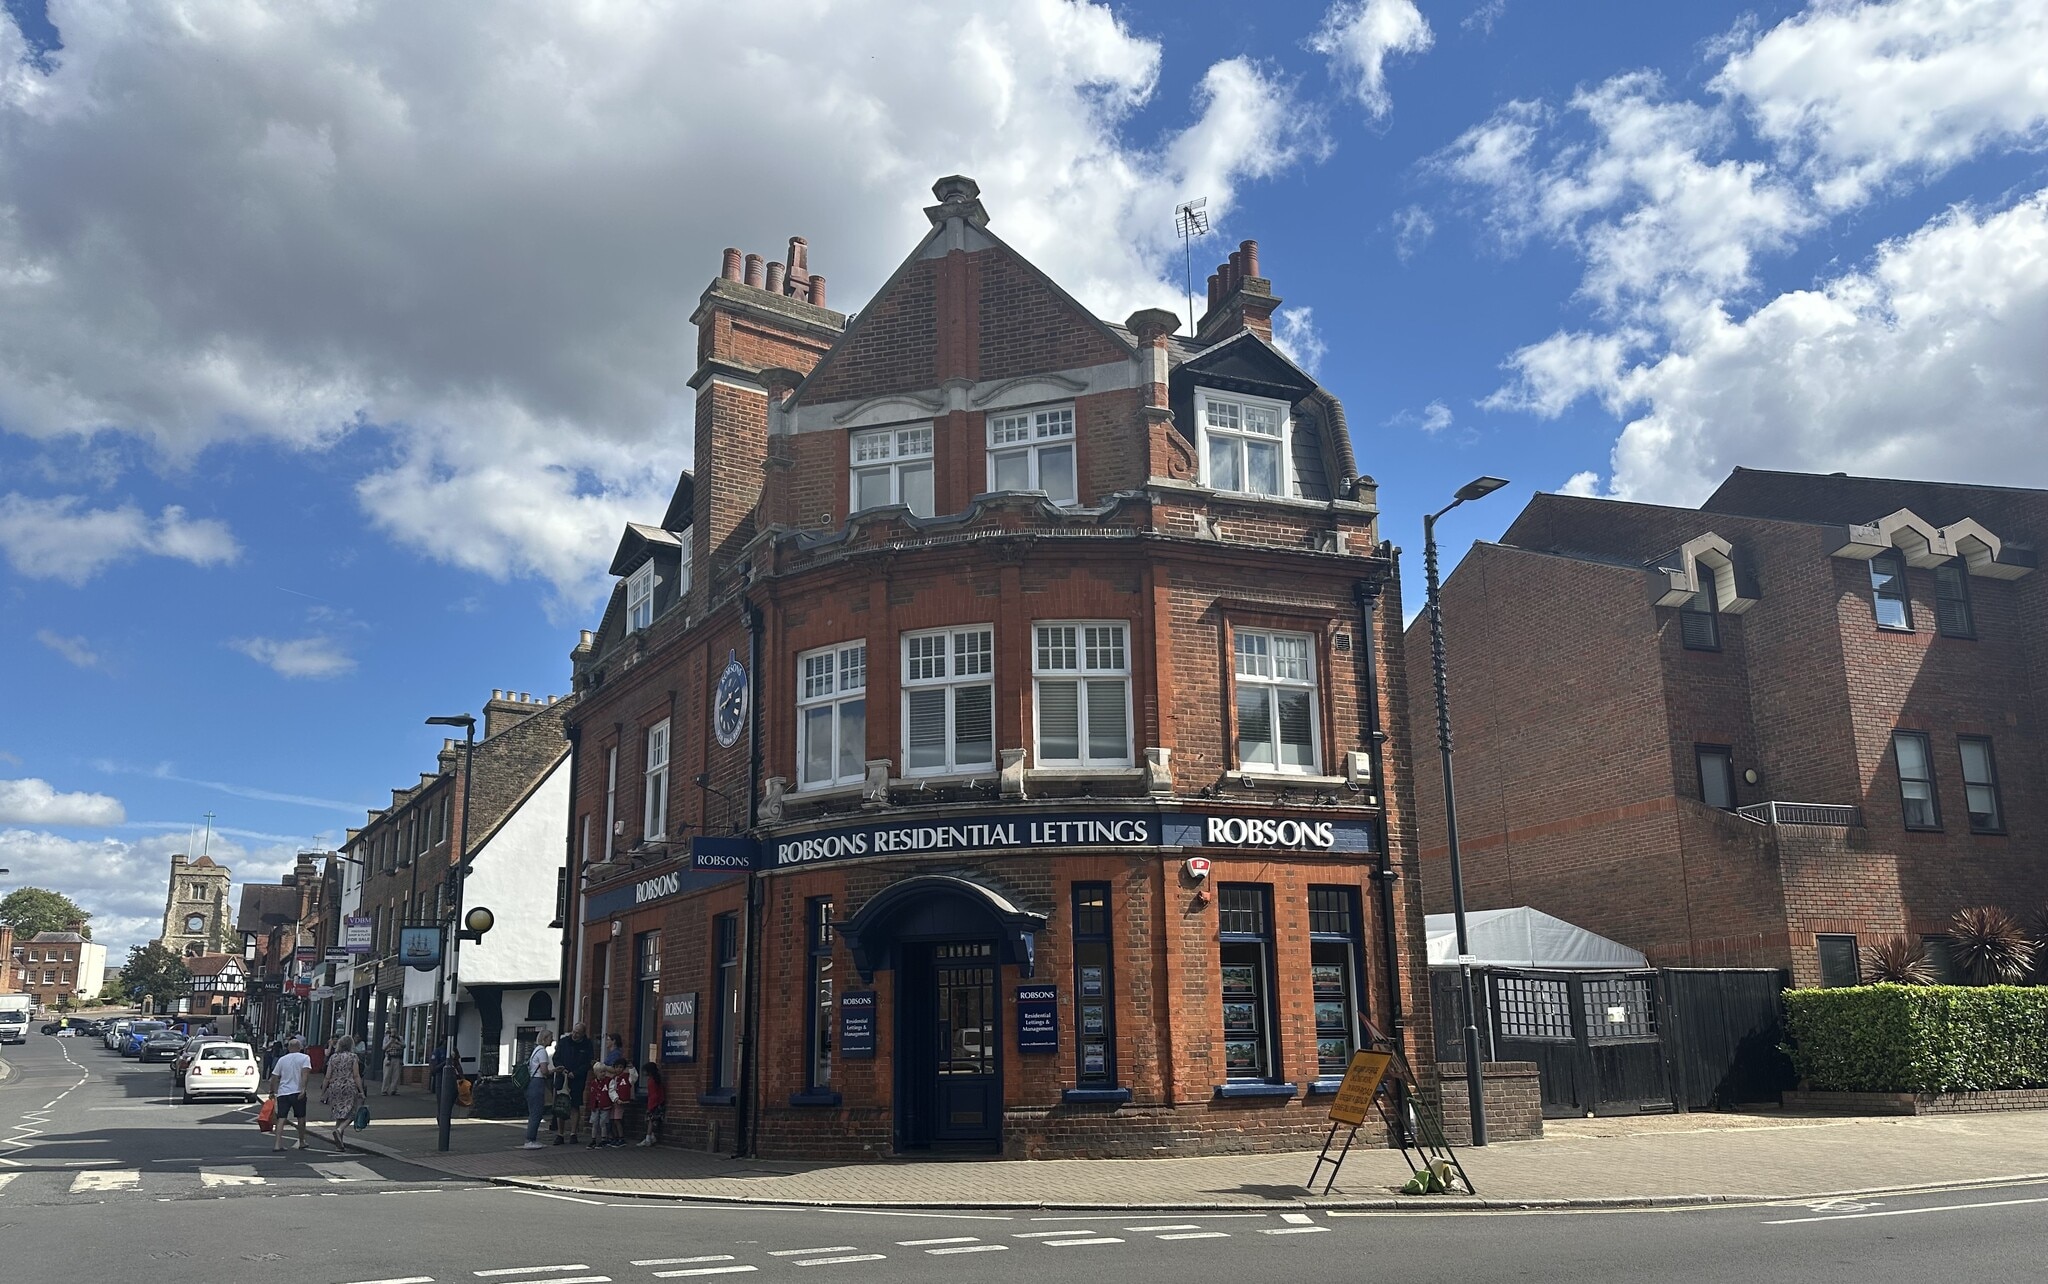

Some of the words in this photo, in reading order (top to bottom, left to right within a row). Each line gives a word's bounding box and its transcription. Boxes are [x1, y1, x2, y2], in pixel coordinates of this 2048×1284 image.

[1208, 817, 1335, 847] ROBSONS
[778, 833, 868, 865] ROBSONS
[873, 823, 1021, 853] RESIDENTIAL
[1029, 820, 1149, 844] LETTINGS
[697, 855, 750, 867] ROBSONS
[636, 872, 678, 903] ROBSONS
[843, 997, 871, 1005] ROBSONS
[1020, 991, 1055, 999] ROBSONS
[665, 1000, 692, 1016] ROBSONS
